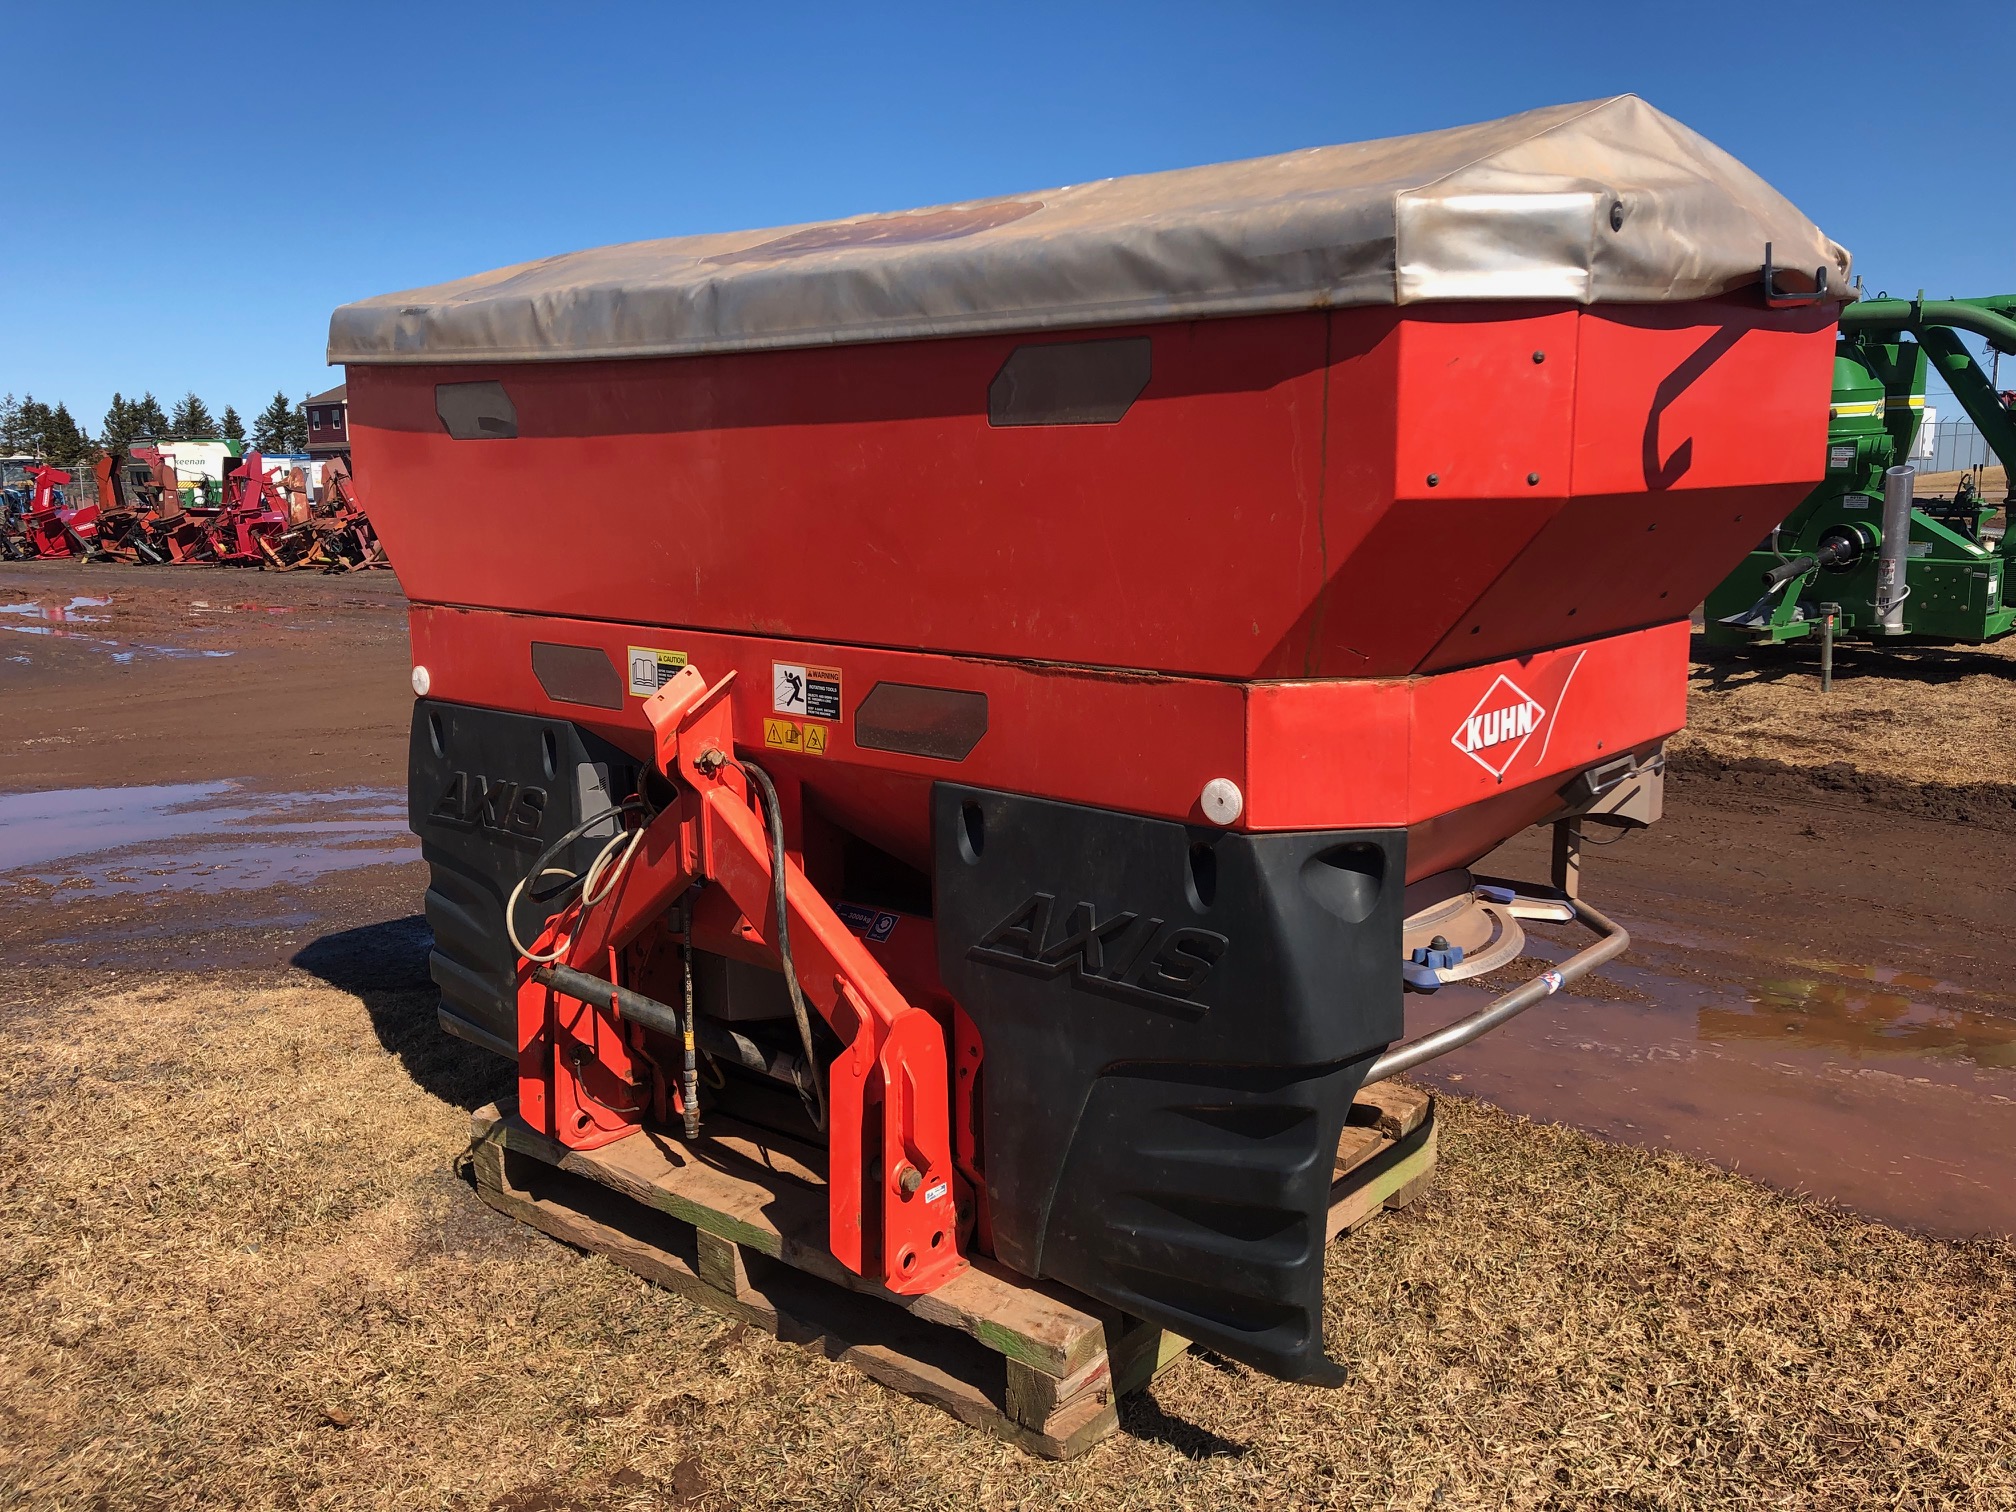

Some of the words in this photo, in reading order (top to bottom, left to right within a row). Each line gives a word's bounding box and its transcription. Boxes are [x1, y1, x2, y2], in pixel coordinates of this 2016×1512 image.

[663, 655, 685, 664] CAUTION
[813, 671, 839, 681] WARNING
[1466, 700, 1533, 754] KUHN
[431, 770, 548, 836] AXIS
[978, 891, 1230, 998] AXIS
